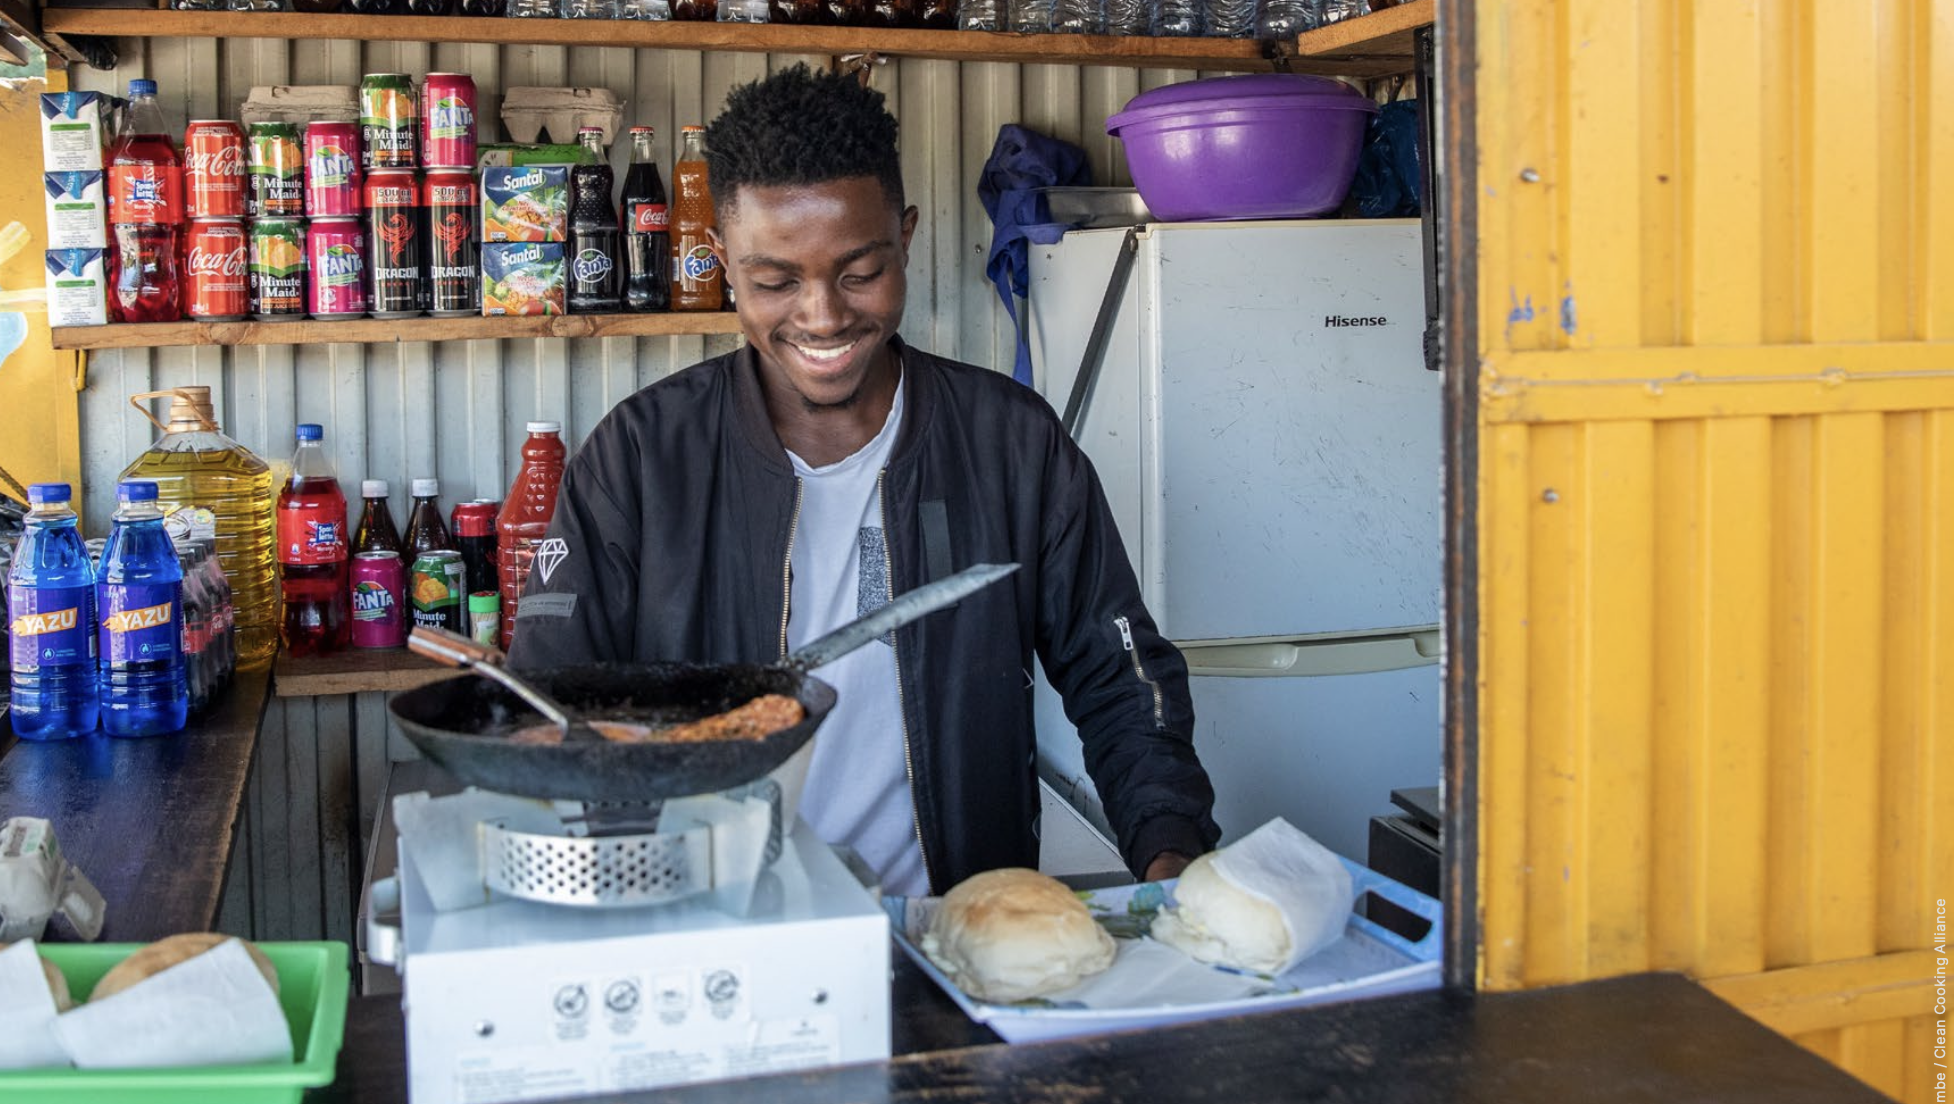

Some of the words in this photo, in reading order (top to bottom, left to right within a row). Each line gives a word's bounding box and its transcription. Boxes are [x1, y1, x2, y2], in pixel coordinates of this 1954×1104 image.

[430, 107, 474, 129] FANTA
[374, 129, 414, 140] Minute
[310, 154, 355, 177] FANTA
[263, 177, 302, 188] Minute
[503, 168, 543, 190] Santal
[270, 188, 299, 199] Maid
[501, 244, 541, 266] Santal
[319, 253, 363, 277] FANTA
[376, 266, 419, 280] DRAGON
[431, 265, 475, 278] DRAGON
[574, 255, 612, 281] Fanta
[260, 275, 301, 287] Minute
[266, 287, 296, 298] Maid
[1324, 315, 1388, 328] Hisense
[353, 589, 395, 610] FANTA
[23, 610, 75, 634] YAZU
[119, 605, 169, 630] YAZU
[413, 608, 447, 621] Minute
